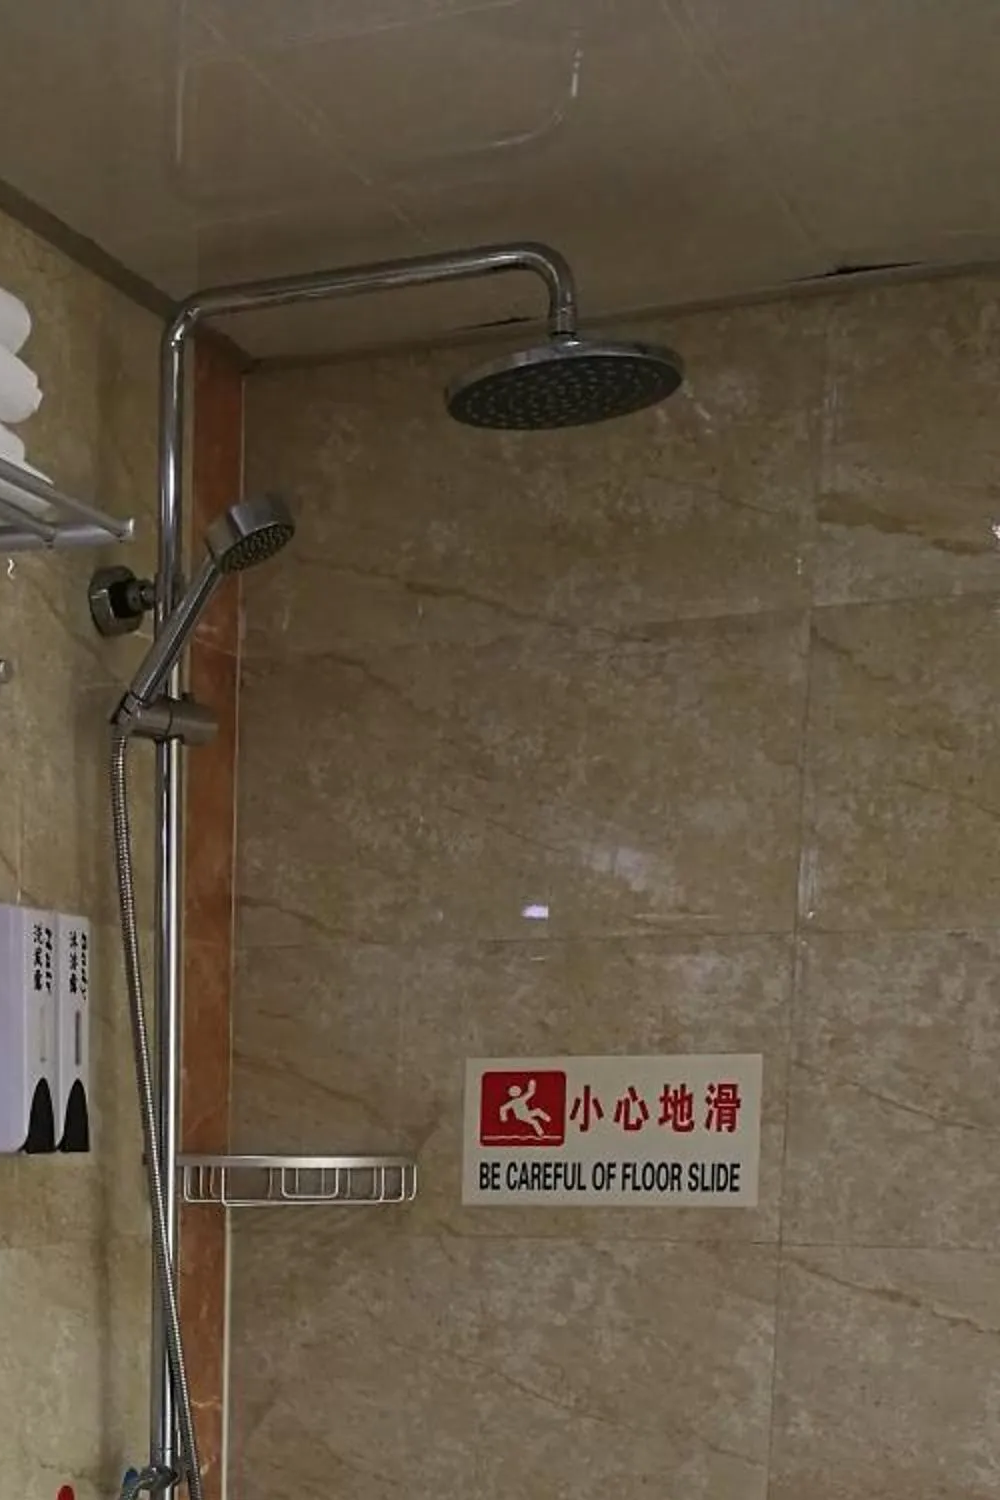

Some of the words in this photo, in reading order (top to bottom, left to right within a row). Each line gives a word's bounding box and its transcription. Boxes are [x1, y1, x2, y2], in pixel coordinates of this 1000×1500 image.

[569, 1083, 742, 1133] 小心地滑
[479, 1162, 501, 1190] BE
[505, 1162, 587, 1191] CAREFUL
[591, 1162, 617, 1191] OF
[621, 1162, 683, 1192] FLOOR
[687, 1162, 741, 1192] SLIDE
